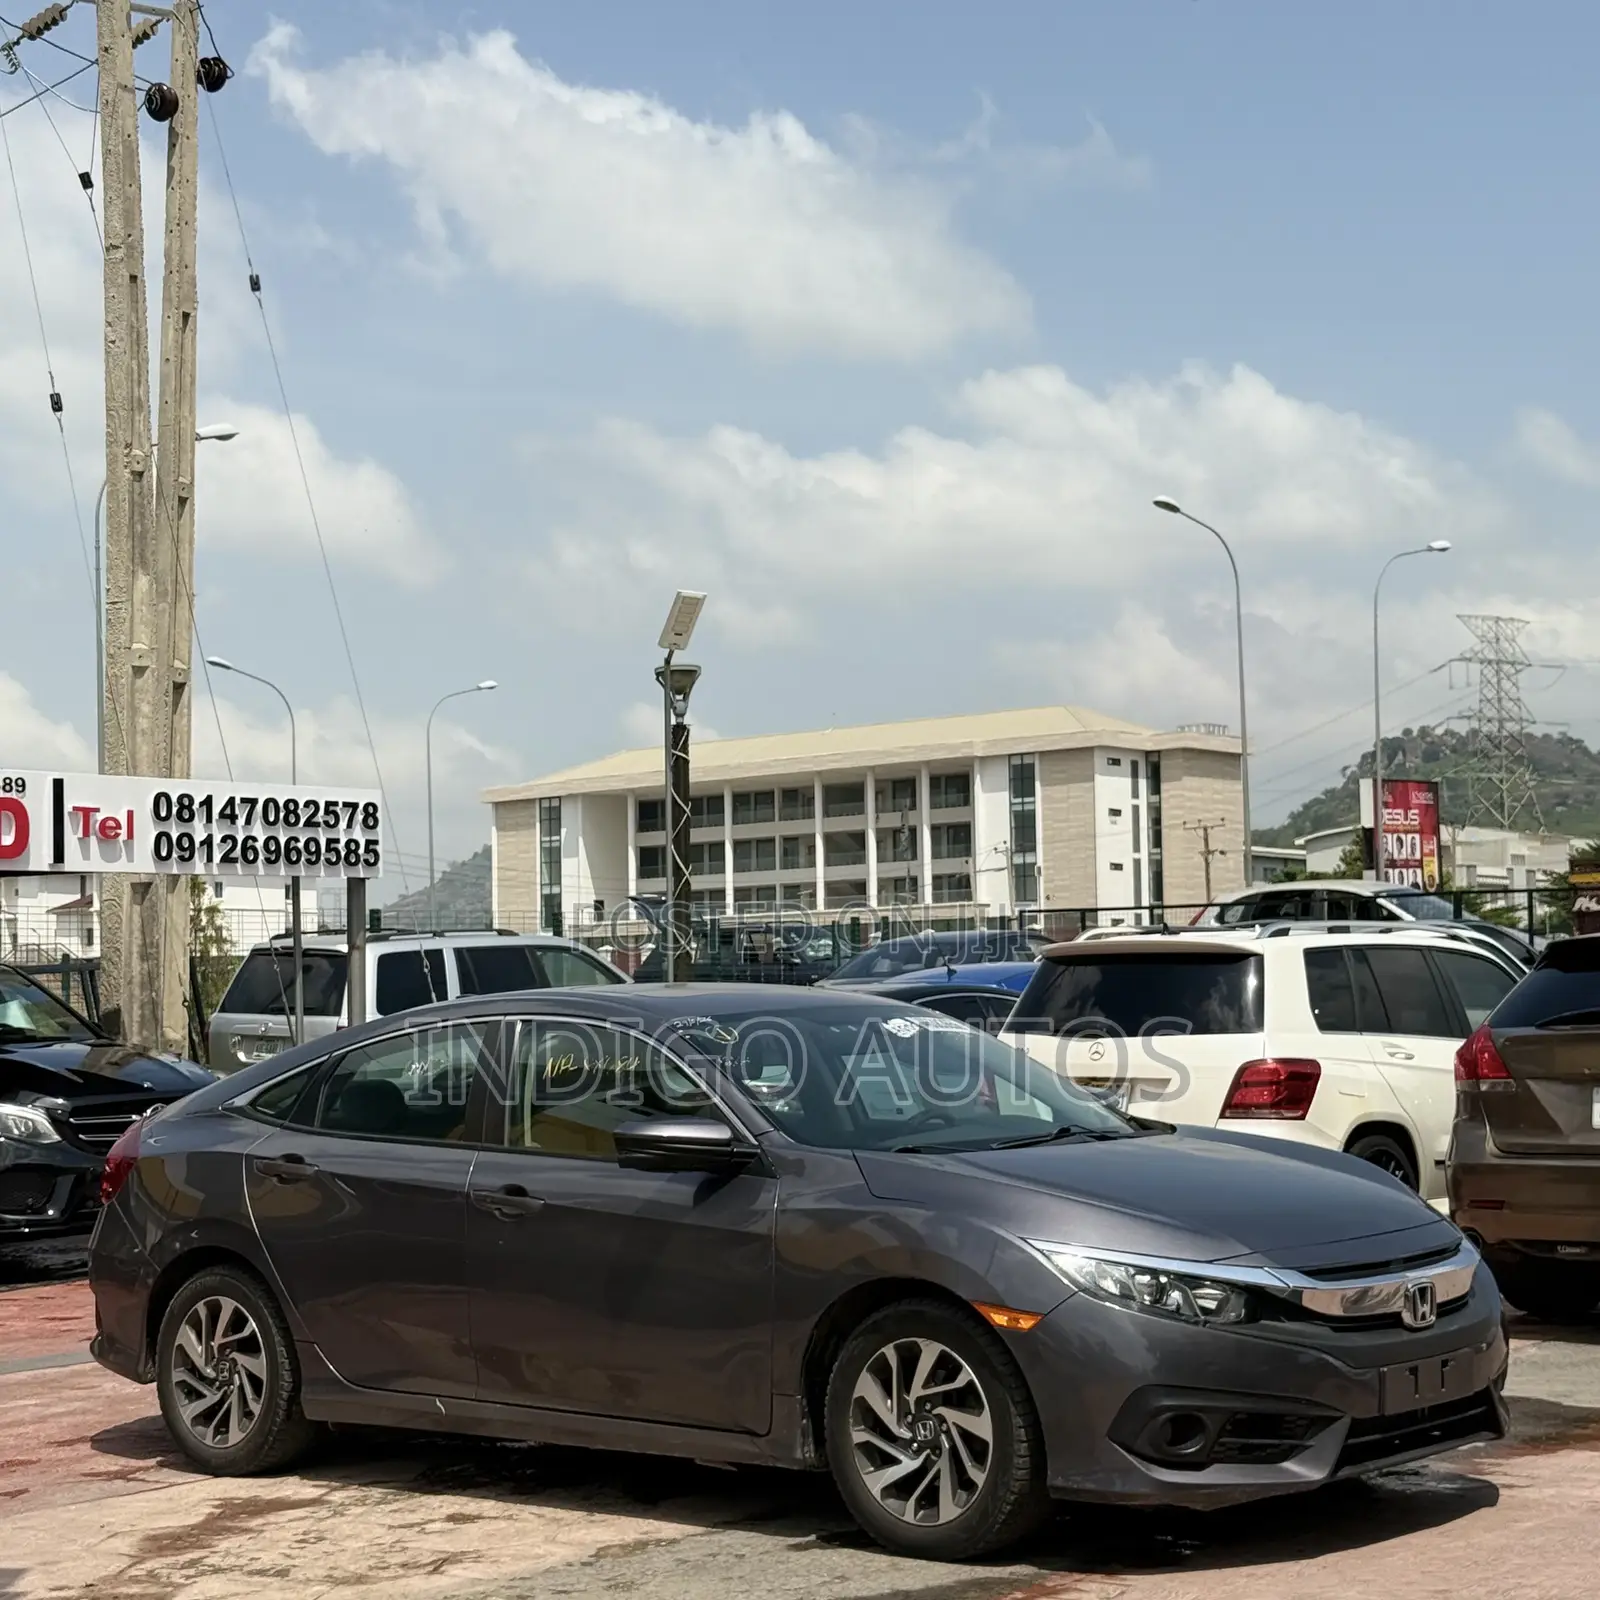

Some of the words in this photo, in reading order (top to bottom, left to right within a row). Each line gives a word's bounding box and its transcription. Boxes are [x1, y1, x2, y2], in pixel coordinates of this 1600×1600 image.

[0, 776, 27, 793] 89
[72, 806, 135, 841] Tel
[152, 791, 379, 830] 08147082578
[153, 831, 381, 867] 09126969585
